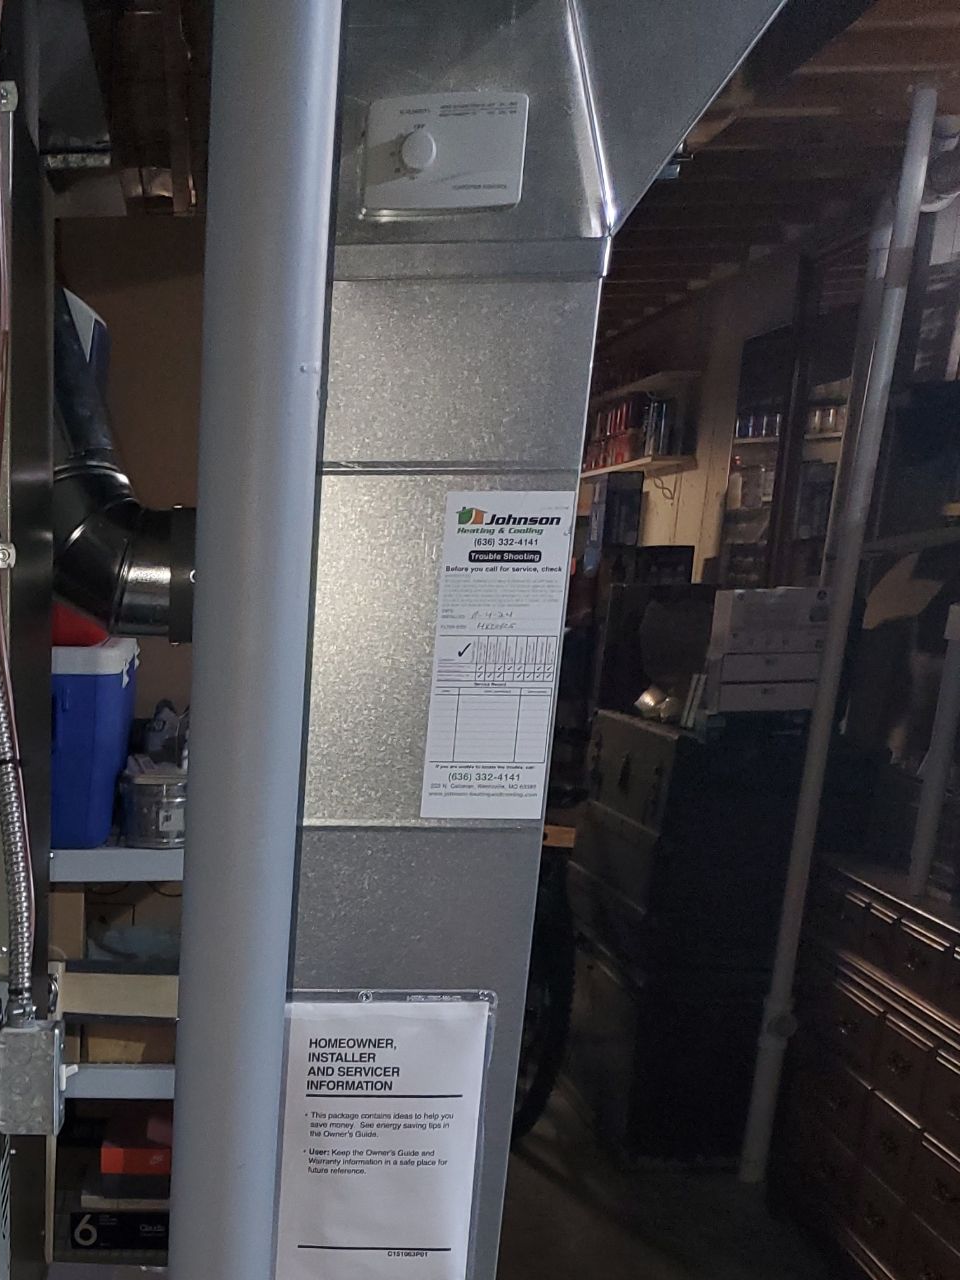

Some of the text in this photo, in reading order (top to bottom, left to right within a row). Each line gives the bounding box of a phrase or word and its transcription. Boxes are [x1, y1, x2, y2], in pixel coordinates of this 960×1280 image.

[485, 514, 561, 526] Johnson
[457, 527, 495, 535] Heating
[508, 527, 544, 535] Cooling
[474, 538, 538, 547] (636) 332-4141
[470, 552, 540, 561] Trouble Shooting
[448, 773, 521, 782] (636) 332-4141
[309, 1038, 398, 1050] HOMEOWNER,
[308, 1052, 376, 1063] INSTALLER
[307, 1066, 400, 1077] AND SERVICER
[306, 1080, 393, 1091] INFORMATION
[328, 1112, 359, 1120] package
[423, 1112, 439, 1121] help
[403, 1122, 426, 1130] saving
[428, 1122, 441, 1130] tips
[331, 1149, 351, 1157] Keep
[308, 1158, 341, 1166] Warranty
[416, 1159, 436, 1167] place
[74, 1214, 98, 1246] 6
